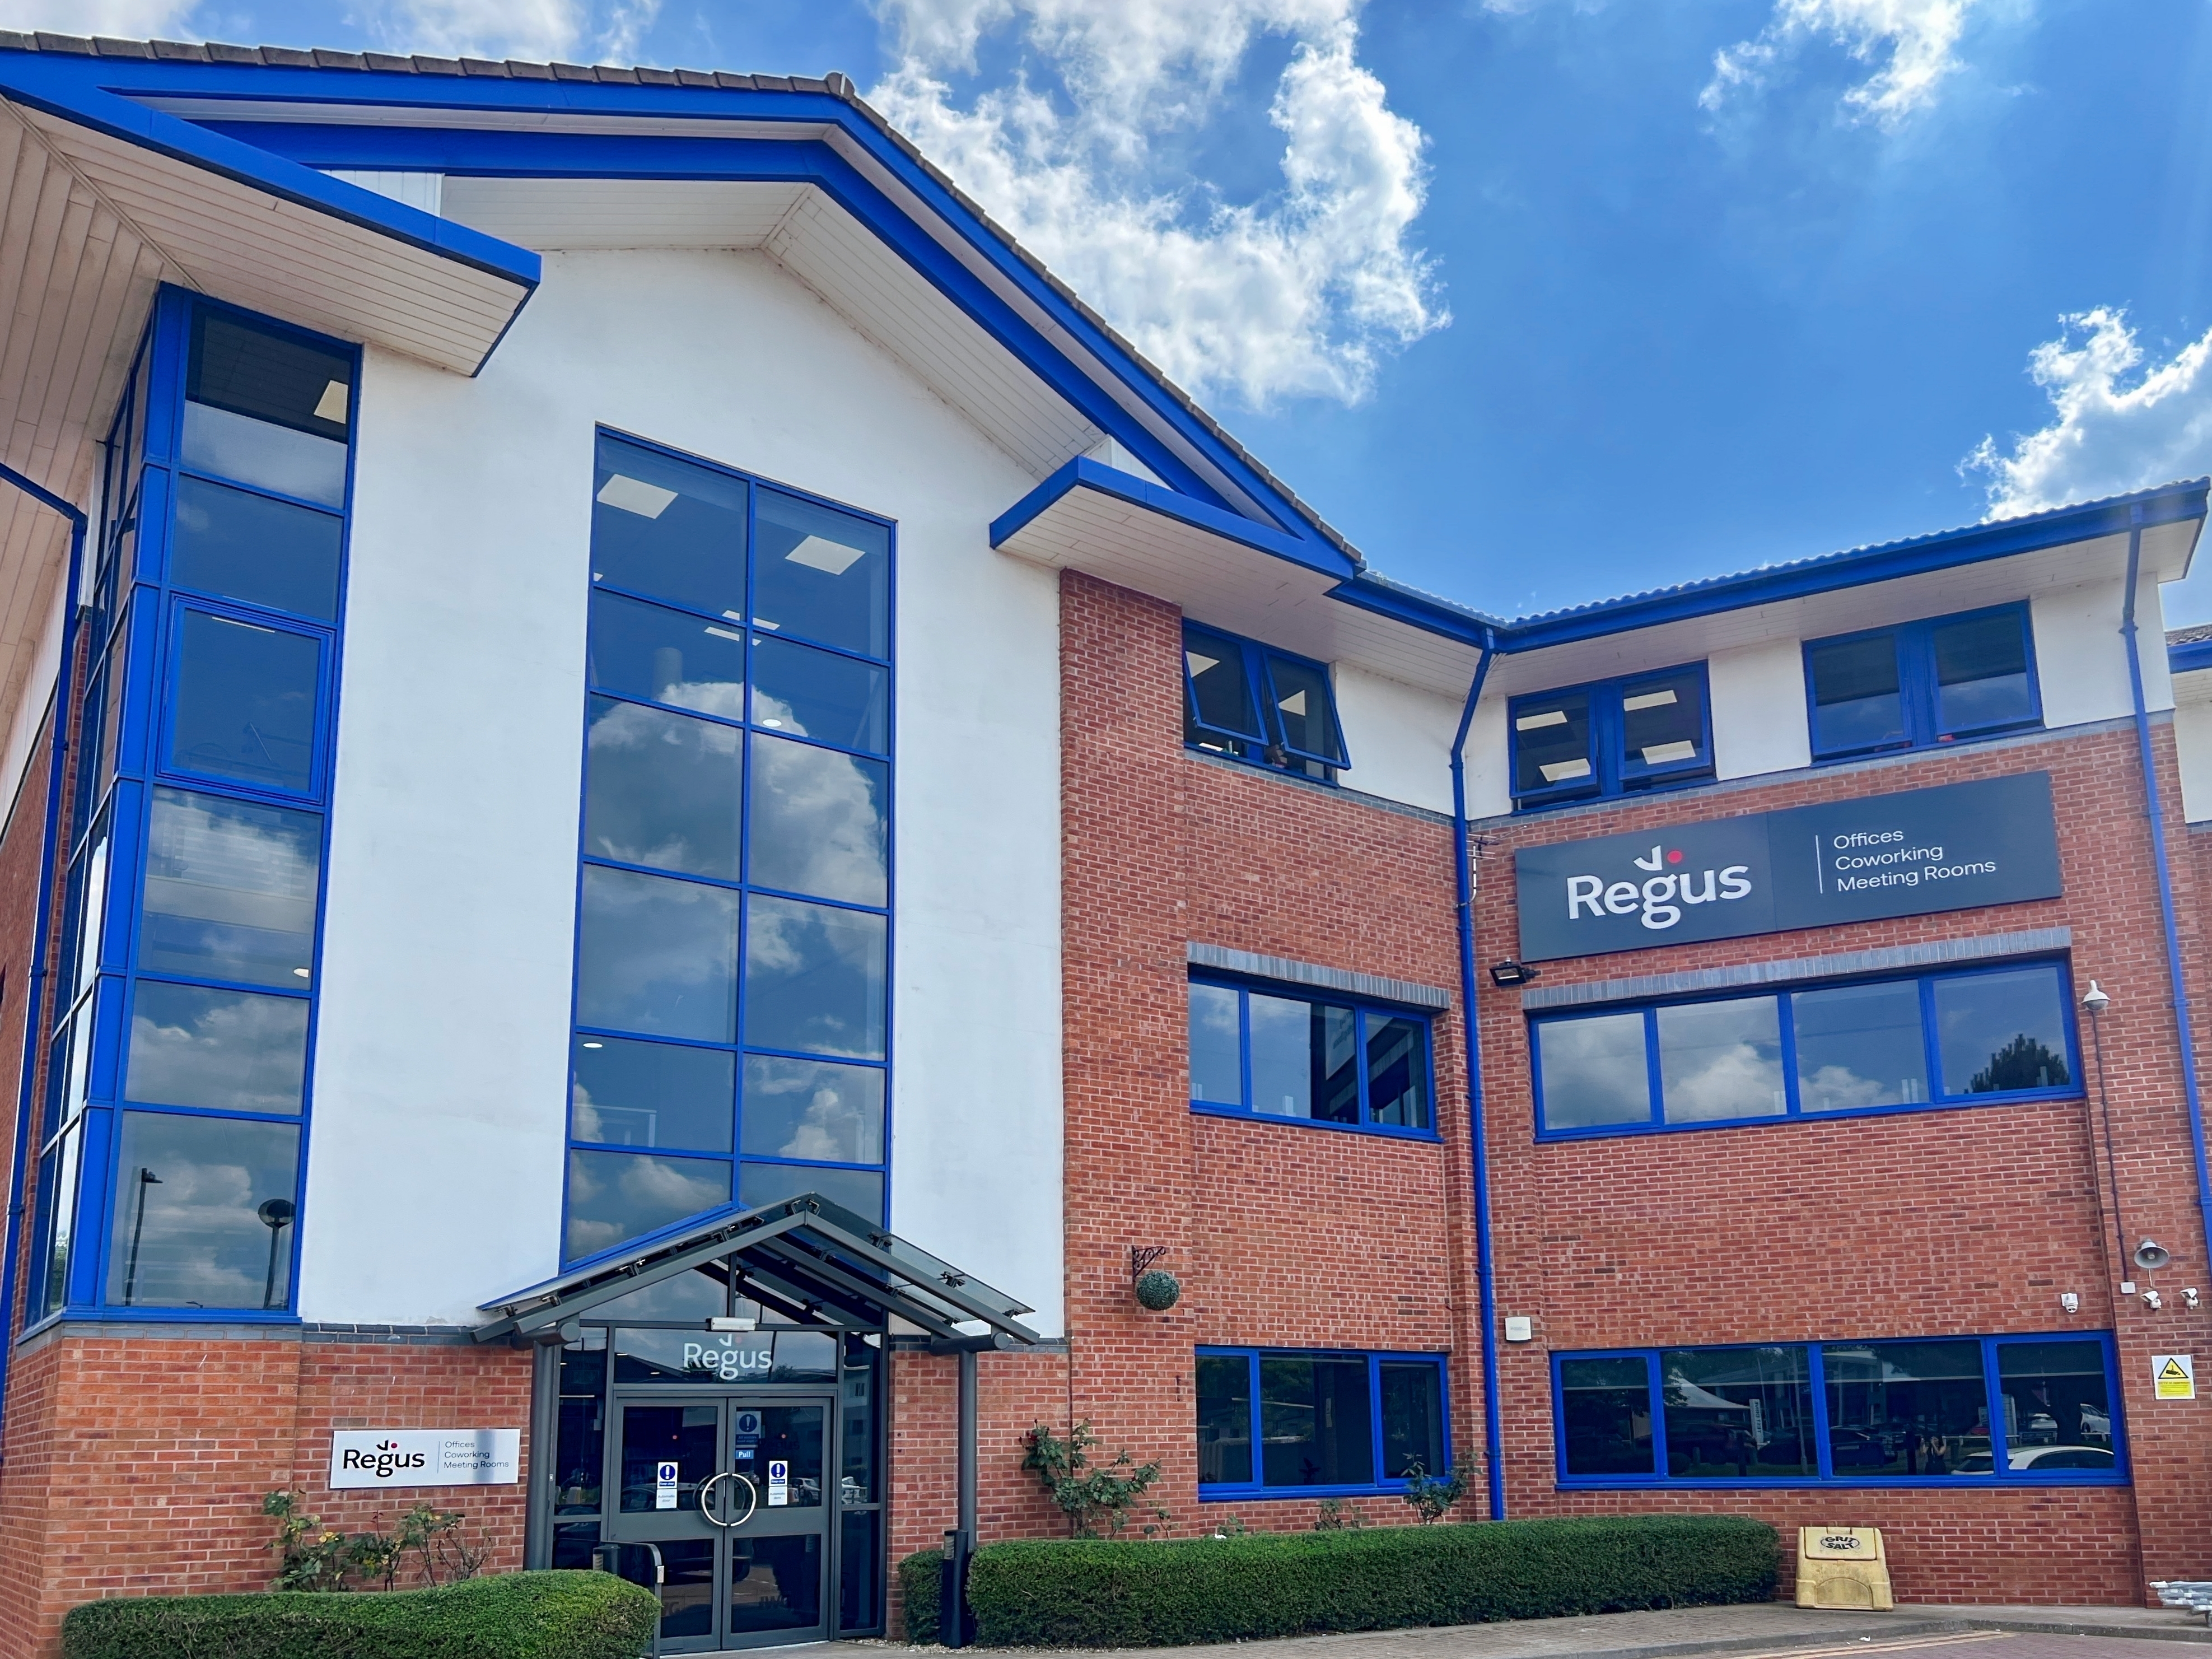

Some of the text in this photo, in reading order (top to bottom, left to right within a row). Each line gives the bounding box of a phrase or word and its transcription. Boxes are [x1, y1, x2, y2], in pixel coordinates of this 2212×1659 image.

[1833, 830, 1904, 849] Offices
[1835, 846, 1943, 870] Coworking
[1837, 861, 1996, 892] Meeting Rooms
[1566, 864, 1752, 930] Regus
[683, 1343, 773, 1381] Regus
[343, 1448, 426, 1478] Regus
[444, 1451, 490, 1459] Coworking
[444, 1461, 478, 1470] Meeting
